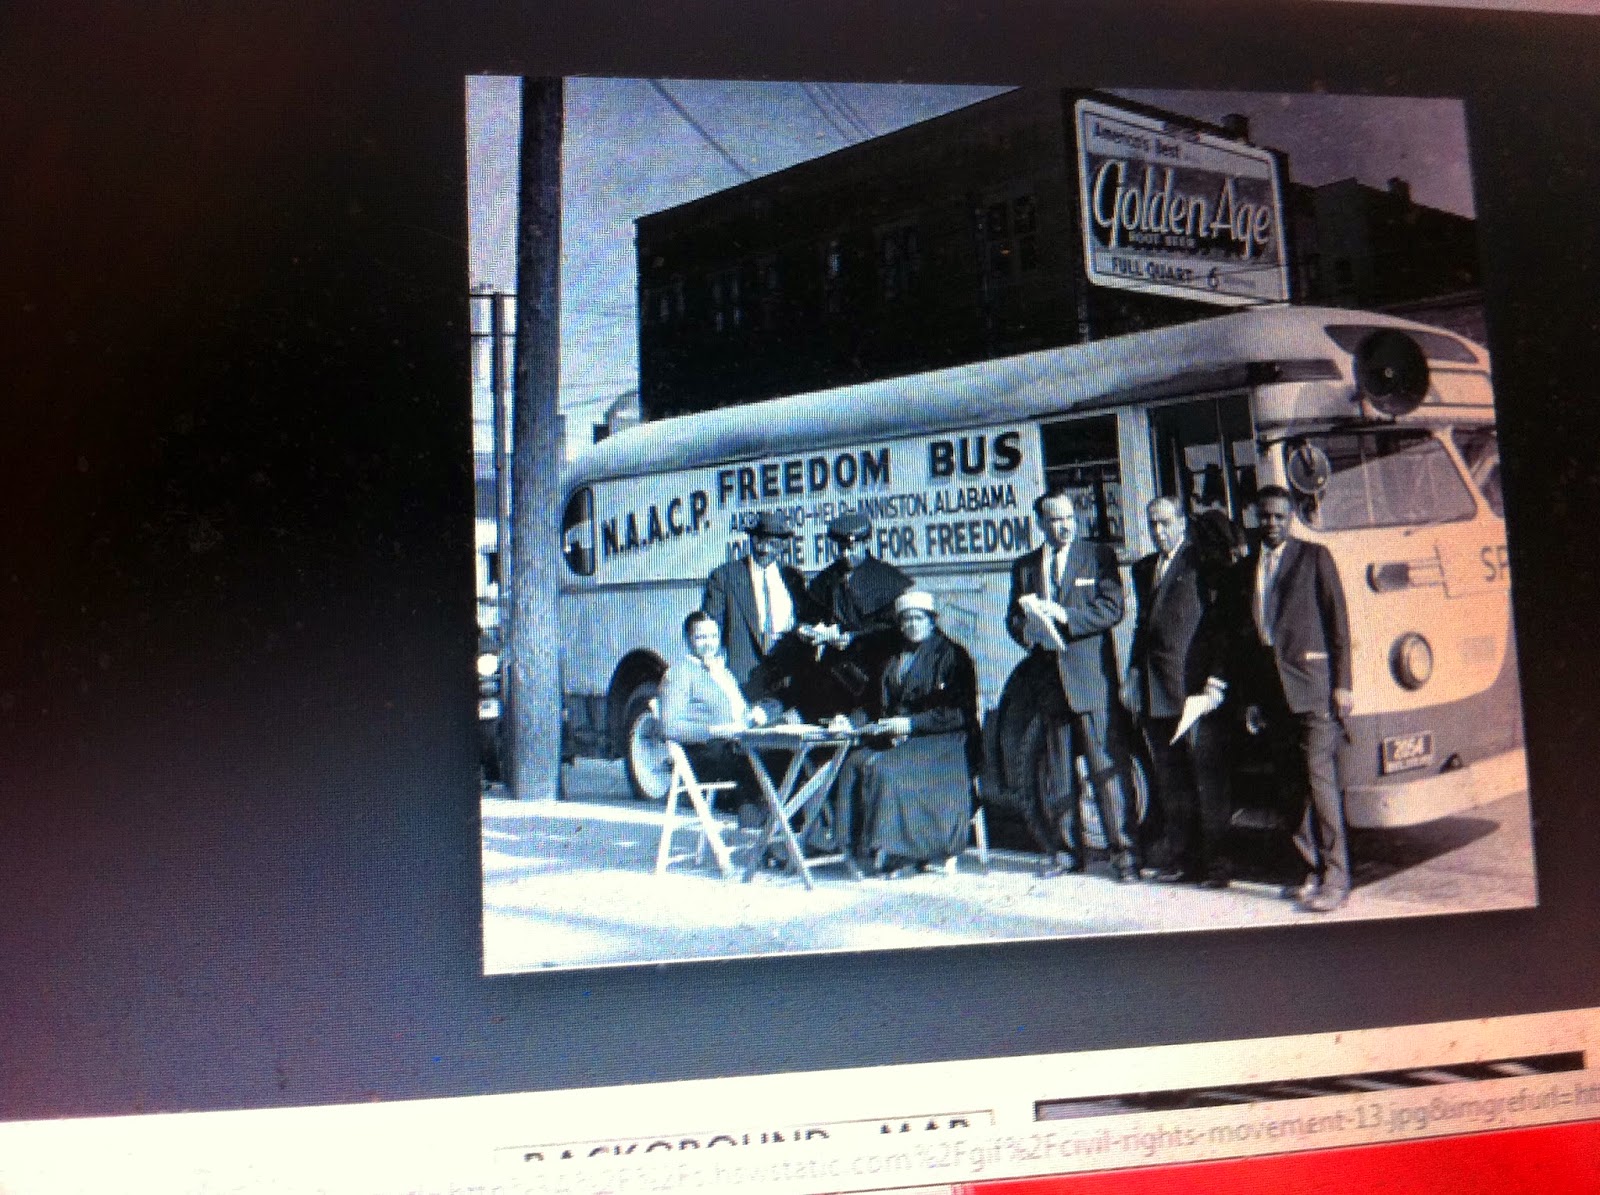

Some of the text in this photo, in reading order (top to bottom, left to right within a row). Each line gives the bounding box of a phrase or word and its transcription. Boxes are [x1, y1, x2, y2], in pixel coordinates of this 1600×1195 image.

[1093, 158, 1271, 261] Golden Age
[1112, 256, 1144, 276] FULL
[1146, 262, 1194, 282] QUART
[719, 431, 1023, 505] FREEDOM BUS
[876, 524, 918, 560] FOR
[926, 515, 1033, 558] FREEDOM
